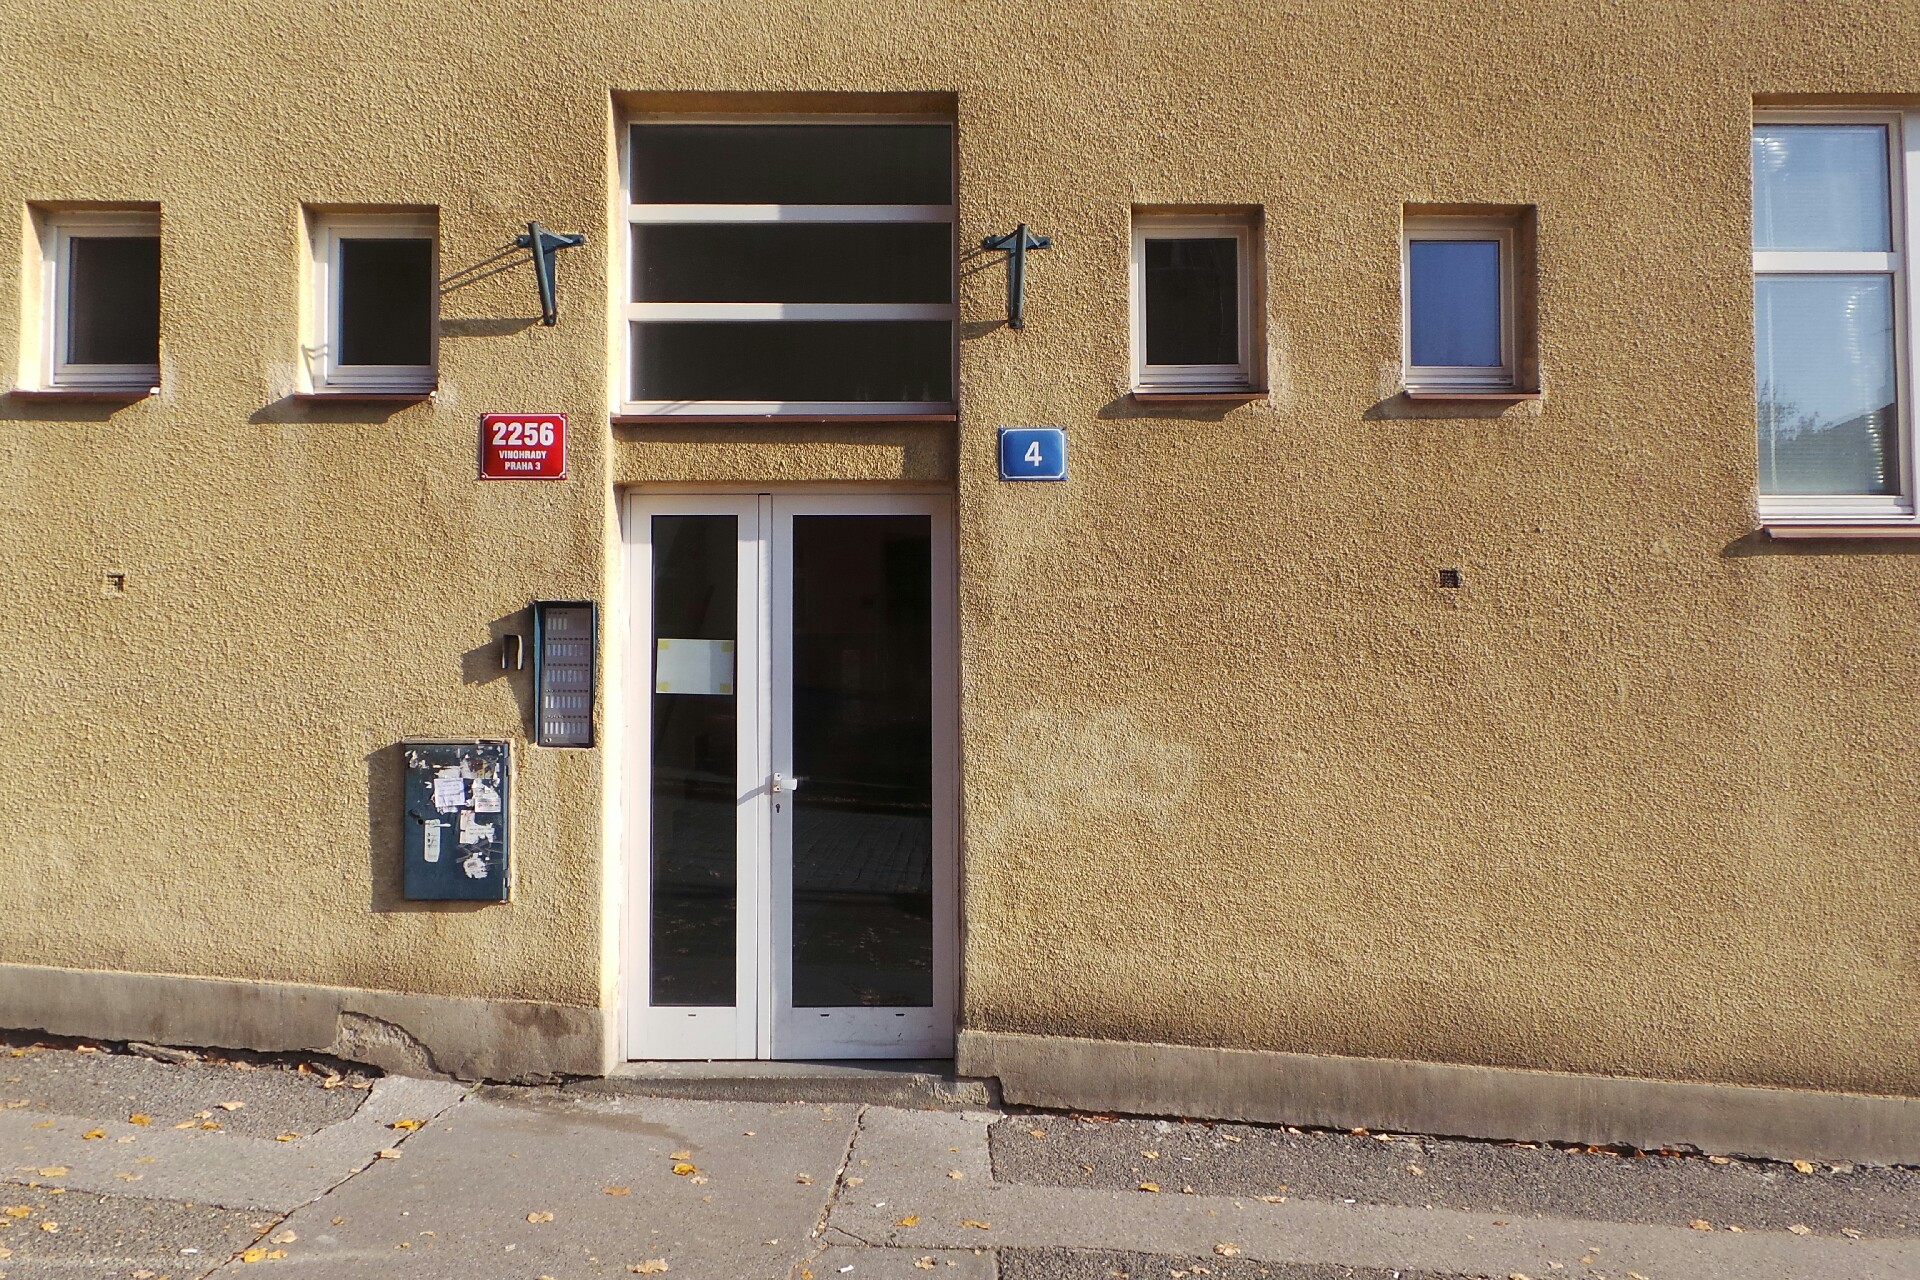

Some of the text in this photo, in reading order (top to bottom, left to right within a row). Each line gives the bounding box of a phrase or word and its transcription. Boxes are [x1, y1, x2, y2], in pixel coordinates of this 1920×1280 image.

[492, 422, 554, 446] 2256
[499, 450, 547, 459] VINOHRADY
[1024, 441, 1043, 467] 4
[504, 461, 541, 470] PRAHA 3
